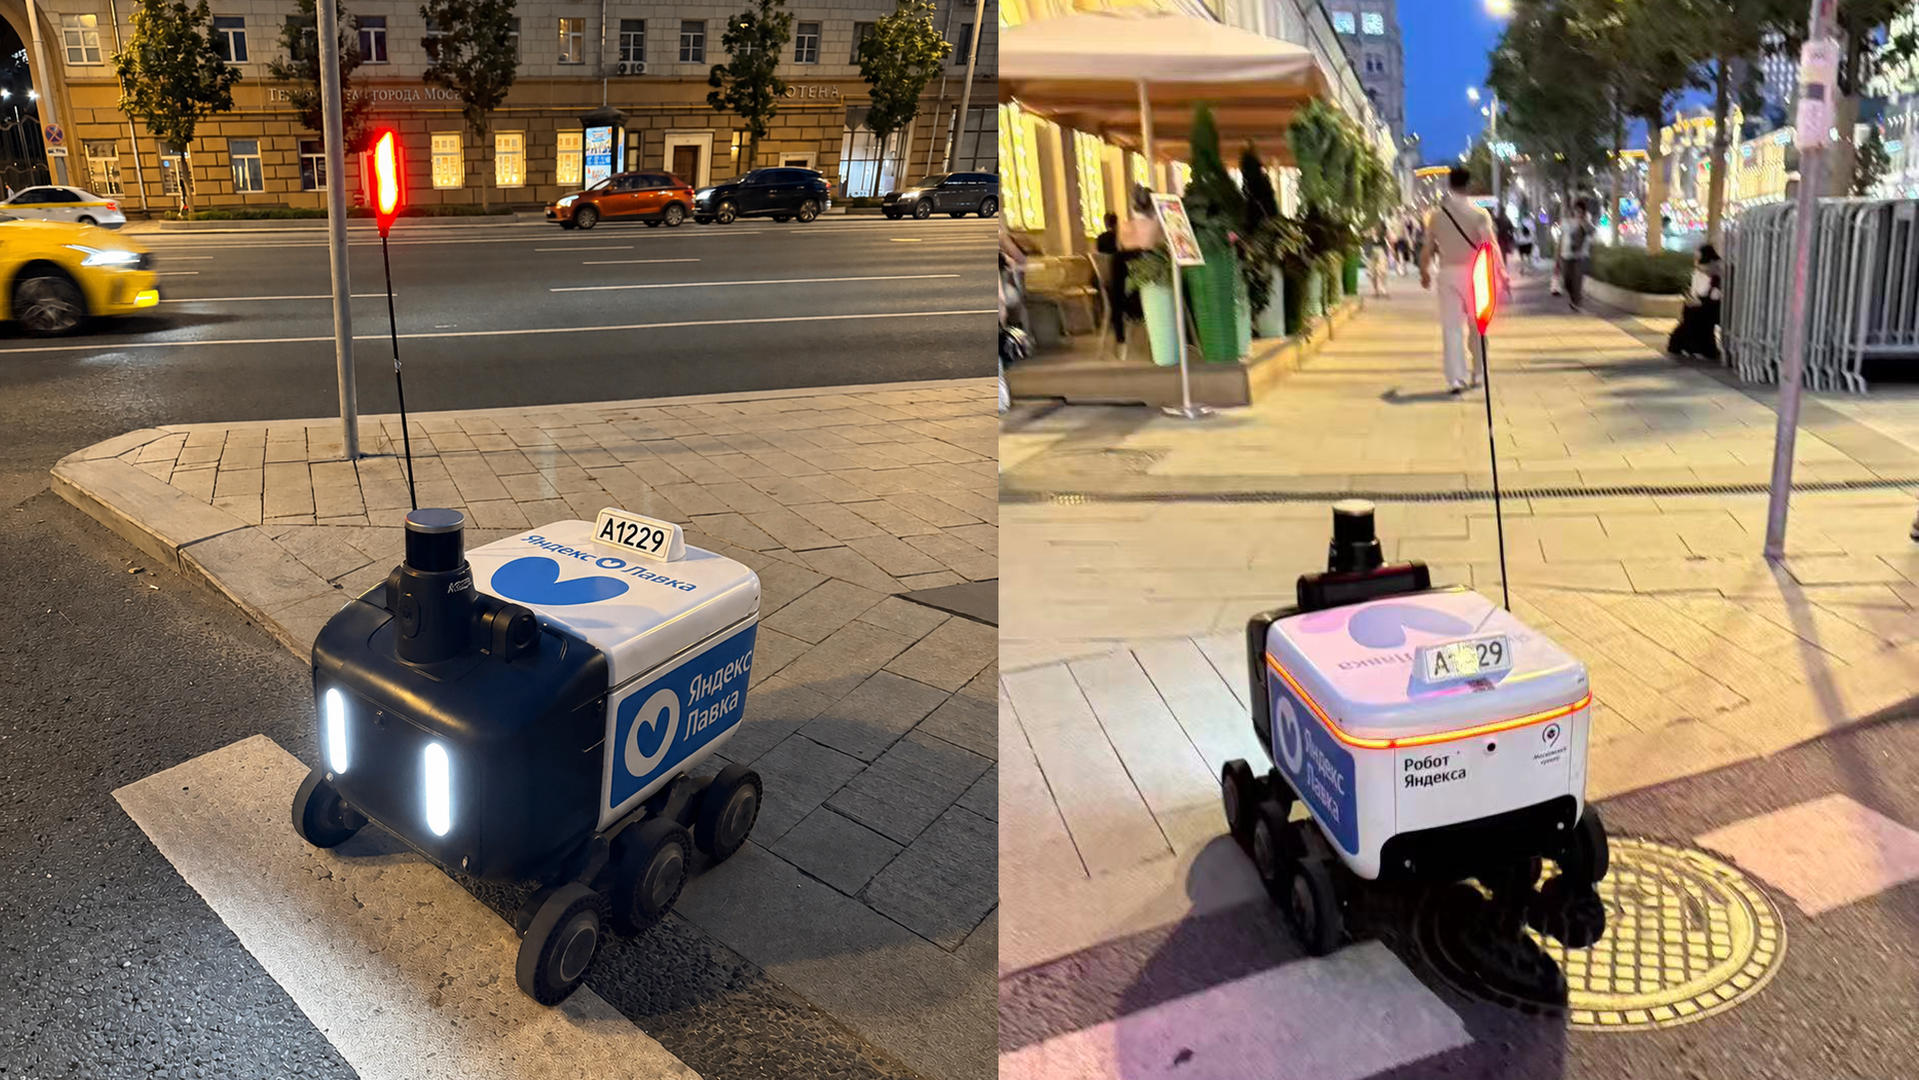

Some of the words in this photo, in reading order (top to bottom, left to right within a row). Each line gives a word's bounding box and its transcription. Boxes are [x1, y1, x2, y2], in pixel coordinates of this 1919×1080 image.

[521, 535, 597, 562] Яндекс
[621, 566, 697, 592] Лавка
[688, 650, 753, 707] Яндекс
[683, 690, 739, 742] Лавка
[1304, 728, 1345, 795] Яндекс
[1404, 755, 1450, 771] Робот
[1404, 768, 1466, 788] Яндекса
[1306, 761, 1341, 823] Лавка
